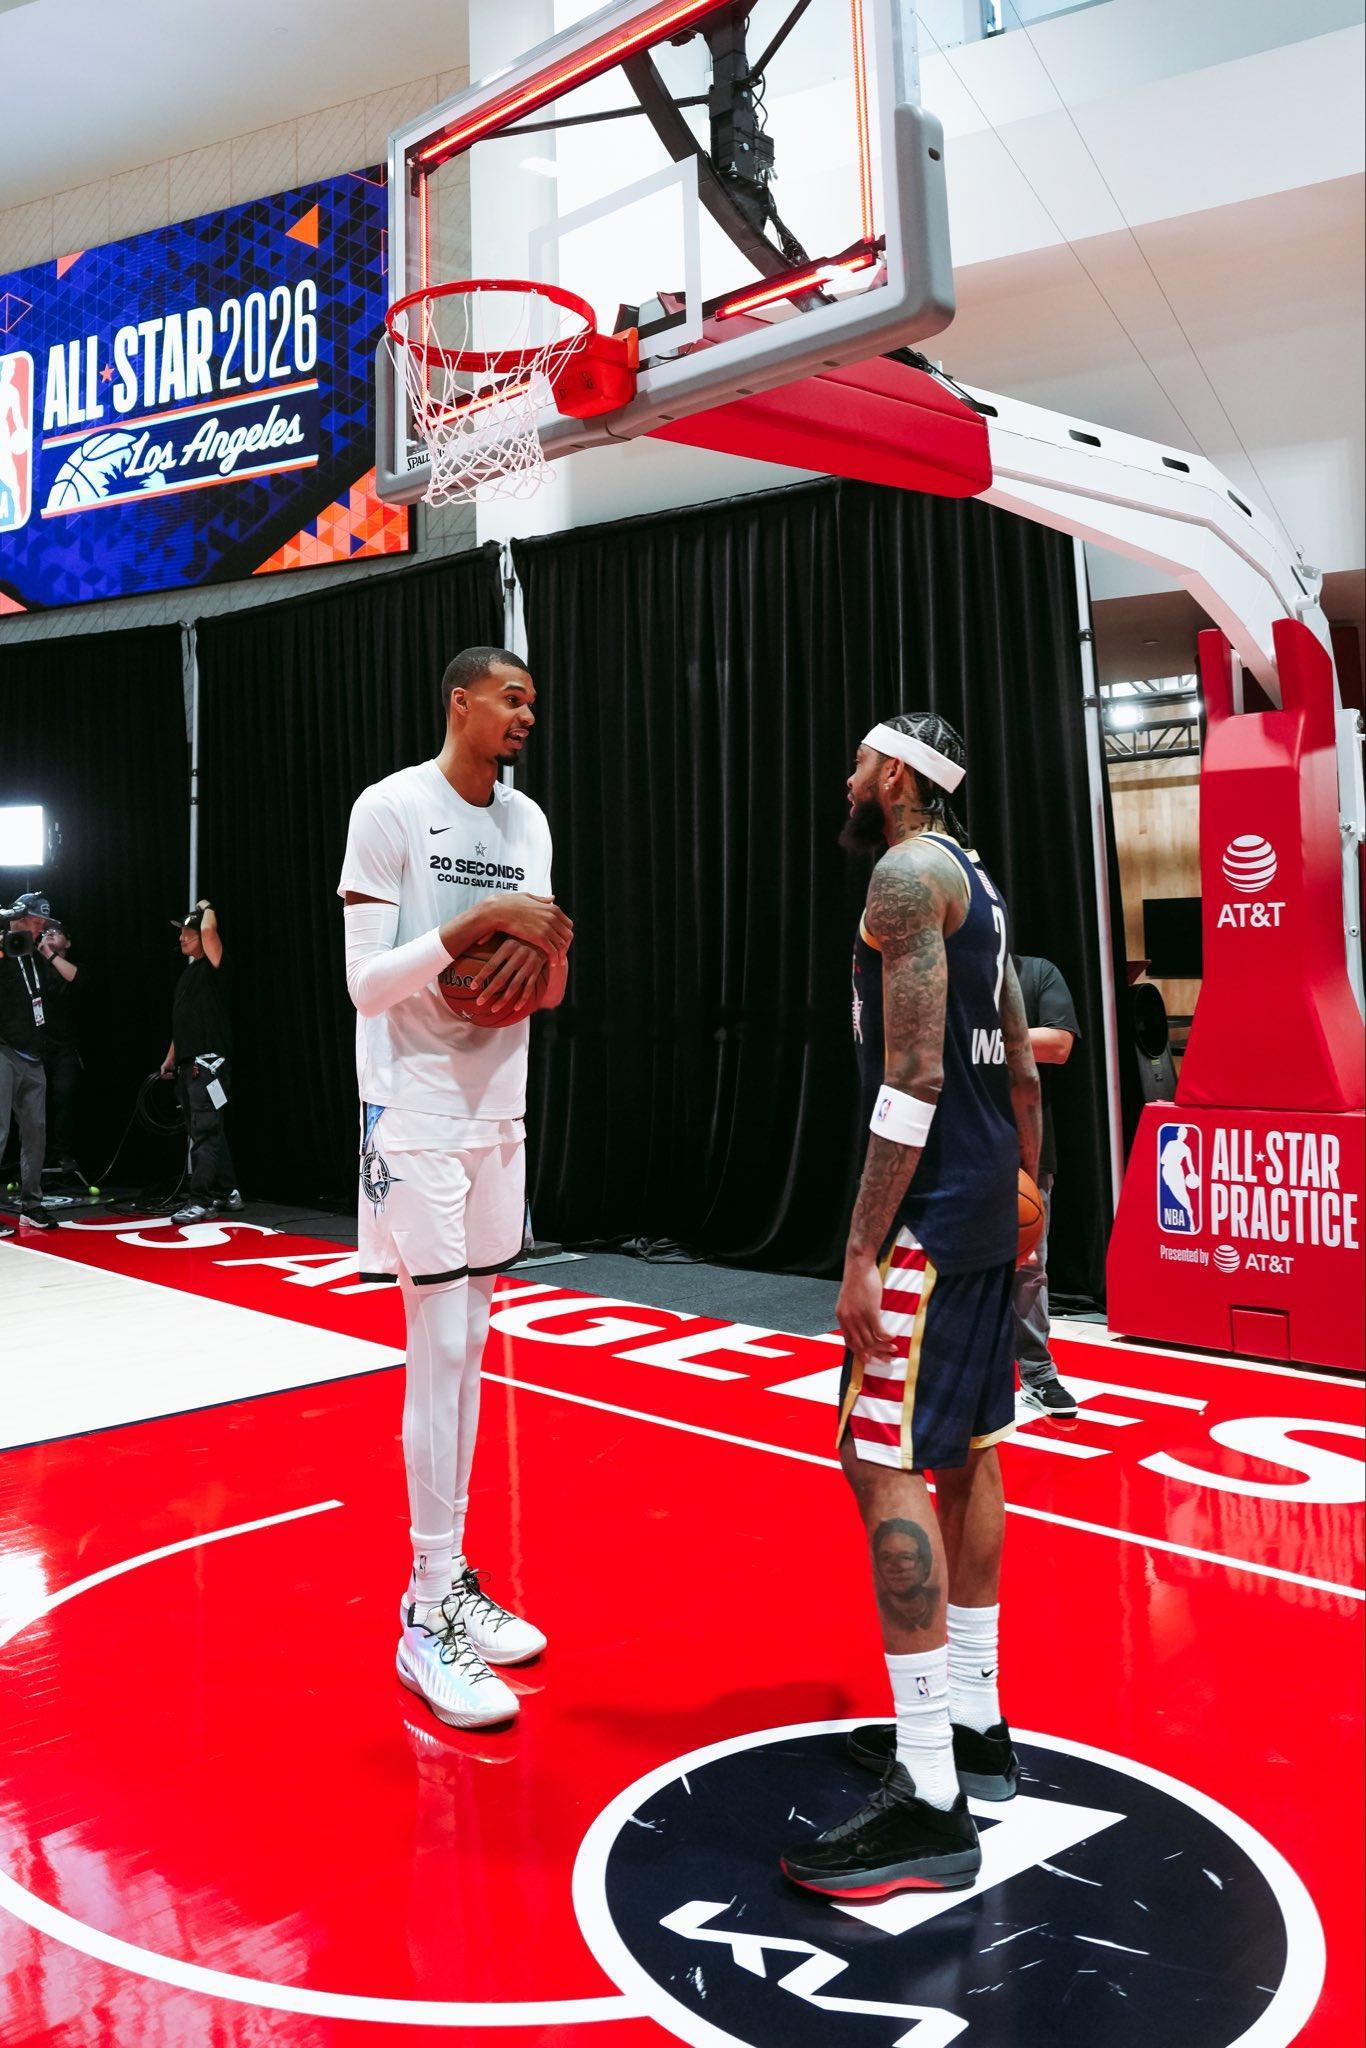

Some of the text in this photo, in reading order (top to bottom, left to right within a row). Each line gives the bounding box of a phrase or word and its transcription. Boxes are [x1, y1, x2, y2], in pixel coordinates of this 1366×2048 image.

[43, 279, 317, 430] ALL STAR 2026
[124, 404, 304, 478] Los Angeles
[429, 855, 525, 881] 20 SECONDS
[437, 873, 470, 885] COULD
[470, 878, 494, 888] SAVE
[502, 882, 518, 891] LIFE
[1217, 901, 1286, 928] AT&T
[1211, 1128, 1340, 1189] ALL STAR
[1164, 1208, 1185, 1226] NBA
[1210, 1183, 1359, 1249] PRACTICE
[1160, 1245, 1209, 1266] Presented by
[1245, 1253, 1294, 1274] AT&T
